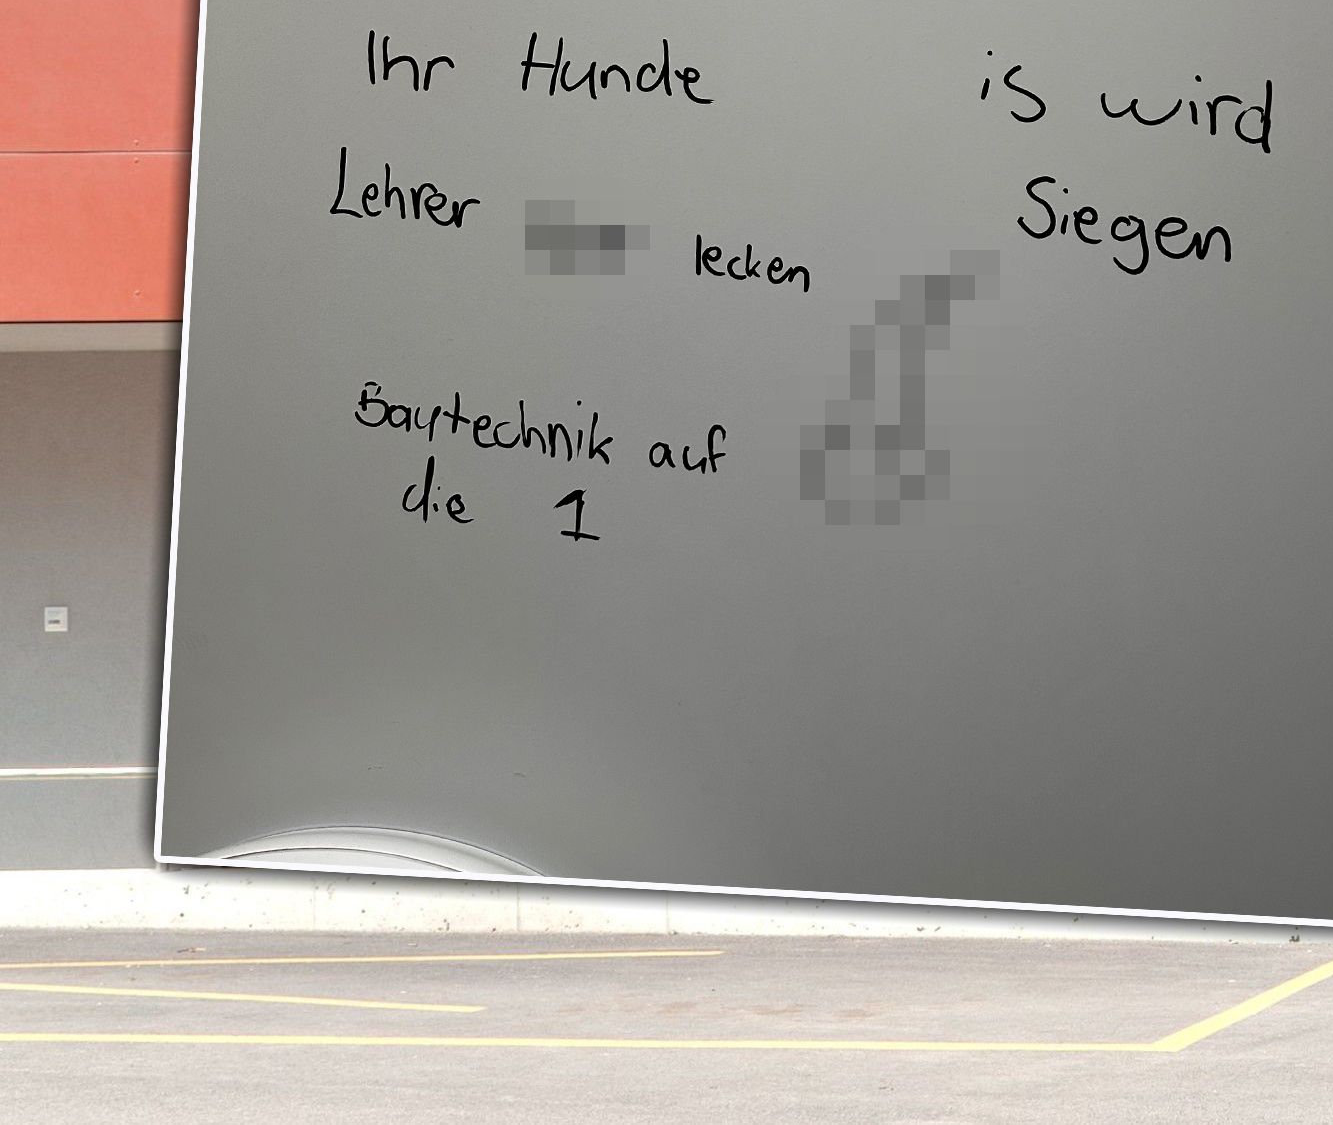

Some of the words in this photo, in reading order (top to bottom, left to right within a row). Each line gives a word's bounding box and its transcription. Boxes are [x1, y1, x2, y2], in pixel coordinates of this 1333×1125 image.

[367, 29, 456, 92] Ihr
[520, 31, 715, 105] Hunde
[1100, 74, 1273, 155] wird
[329, 146, 481, 229] Lehrer
[695, 233, 811, 293] lecken
[1016, 175, 1232, 276] Siegen
[648, 424, 727, 475] auf
[401, 455, 475, 524] die
[553, 489, 601, 542] 1
